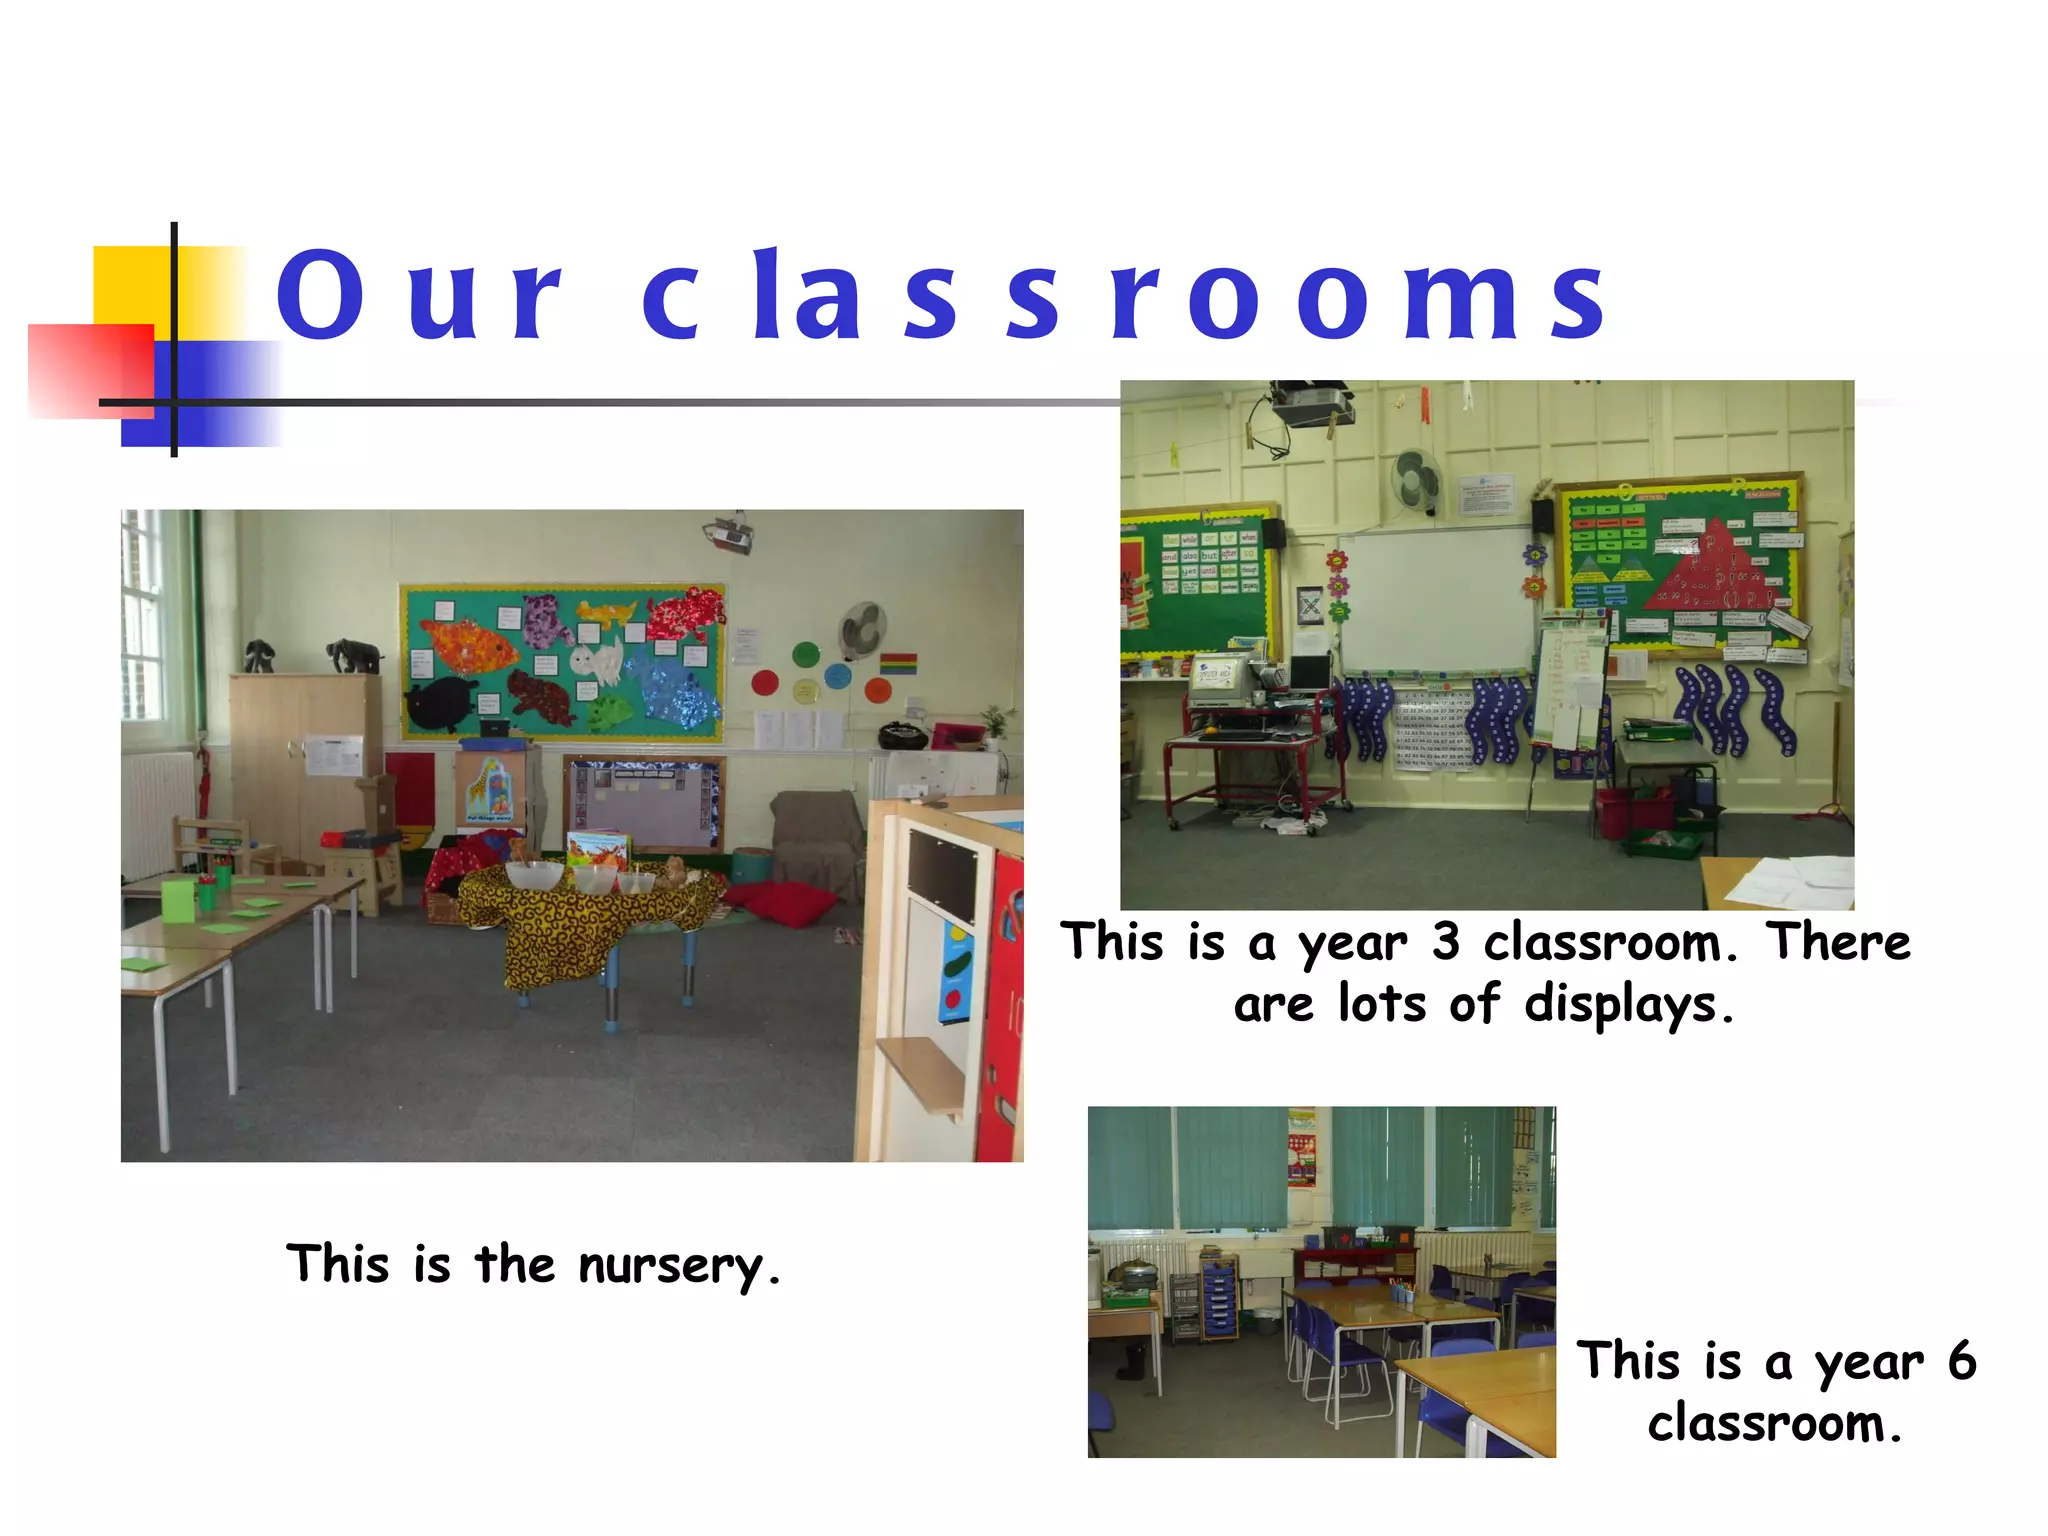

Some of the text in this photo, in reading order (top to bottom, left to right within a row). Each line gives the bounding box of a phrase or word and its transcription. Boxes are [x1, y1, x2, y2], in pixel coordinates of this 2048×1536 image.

[1182, 552, 1198, 560] also
[1201, 552, 1217, 560] but
[1182, 567, 1197, 576] yet
